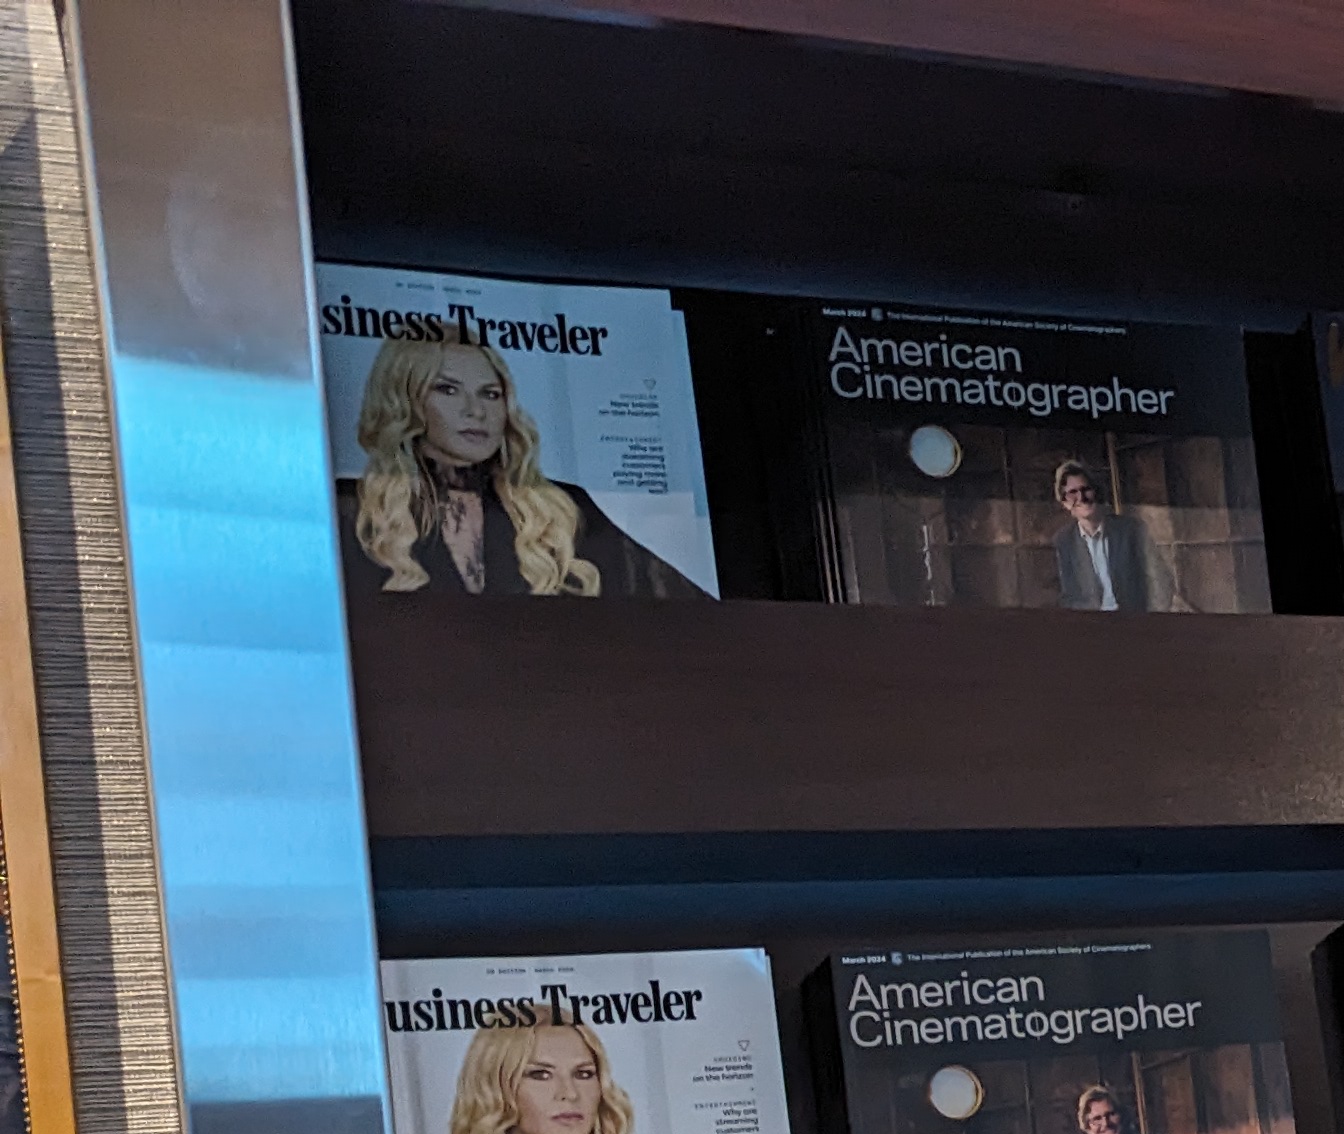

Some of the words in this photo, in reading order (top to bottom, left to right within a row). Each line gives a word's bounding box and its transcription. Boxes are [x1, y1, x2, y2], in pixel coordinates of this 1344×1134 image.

[322, 294, 444, 343] siness
[447, 302, 608, 357] Traveler
[828, 326, 1023, 373] American
[830, 361, 1176, 419] Cinematographer
[384, 987, 537, 1033] usiness
[540, 979, 703, 1027] Traveler
[848, 969, 1046, 1012] American
[849, 993, 1202, 1048] Cinematographer
